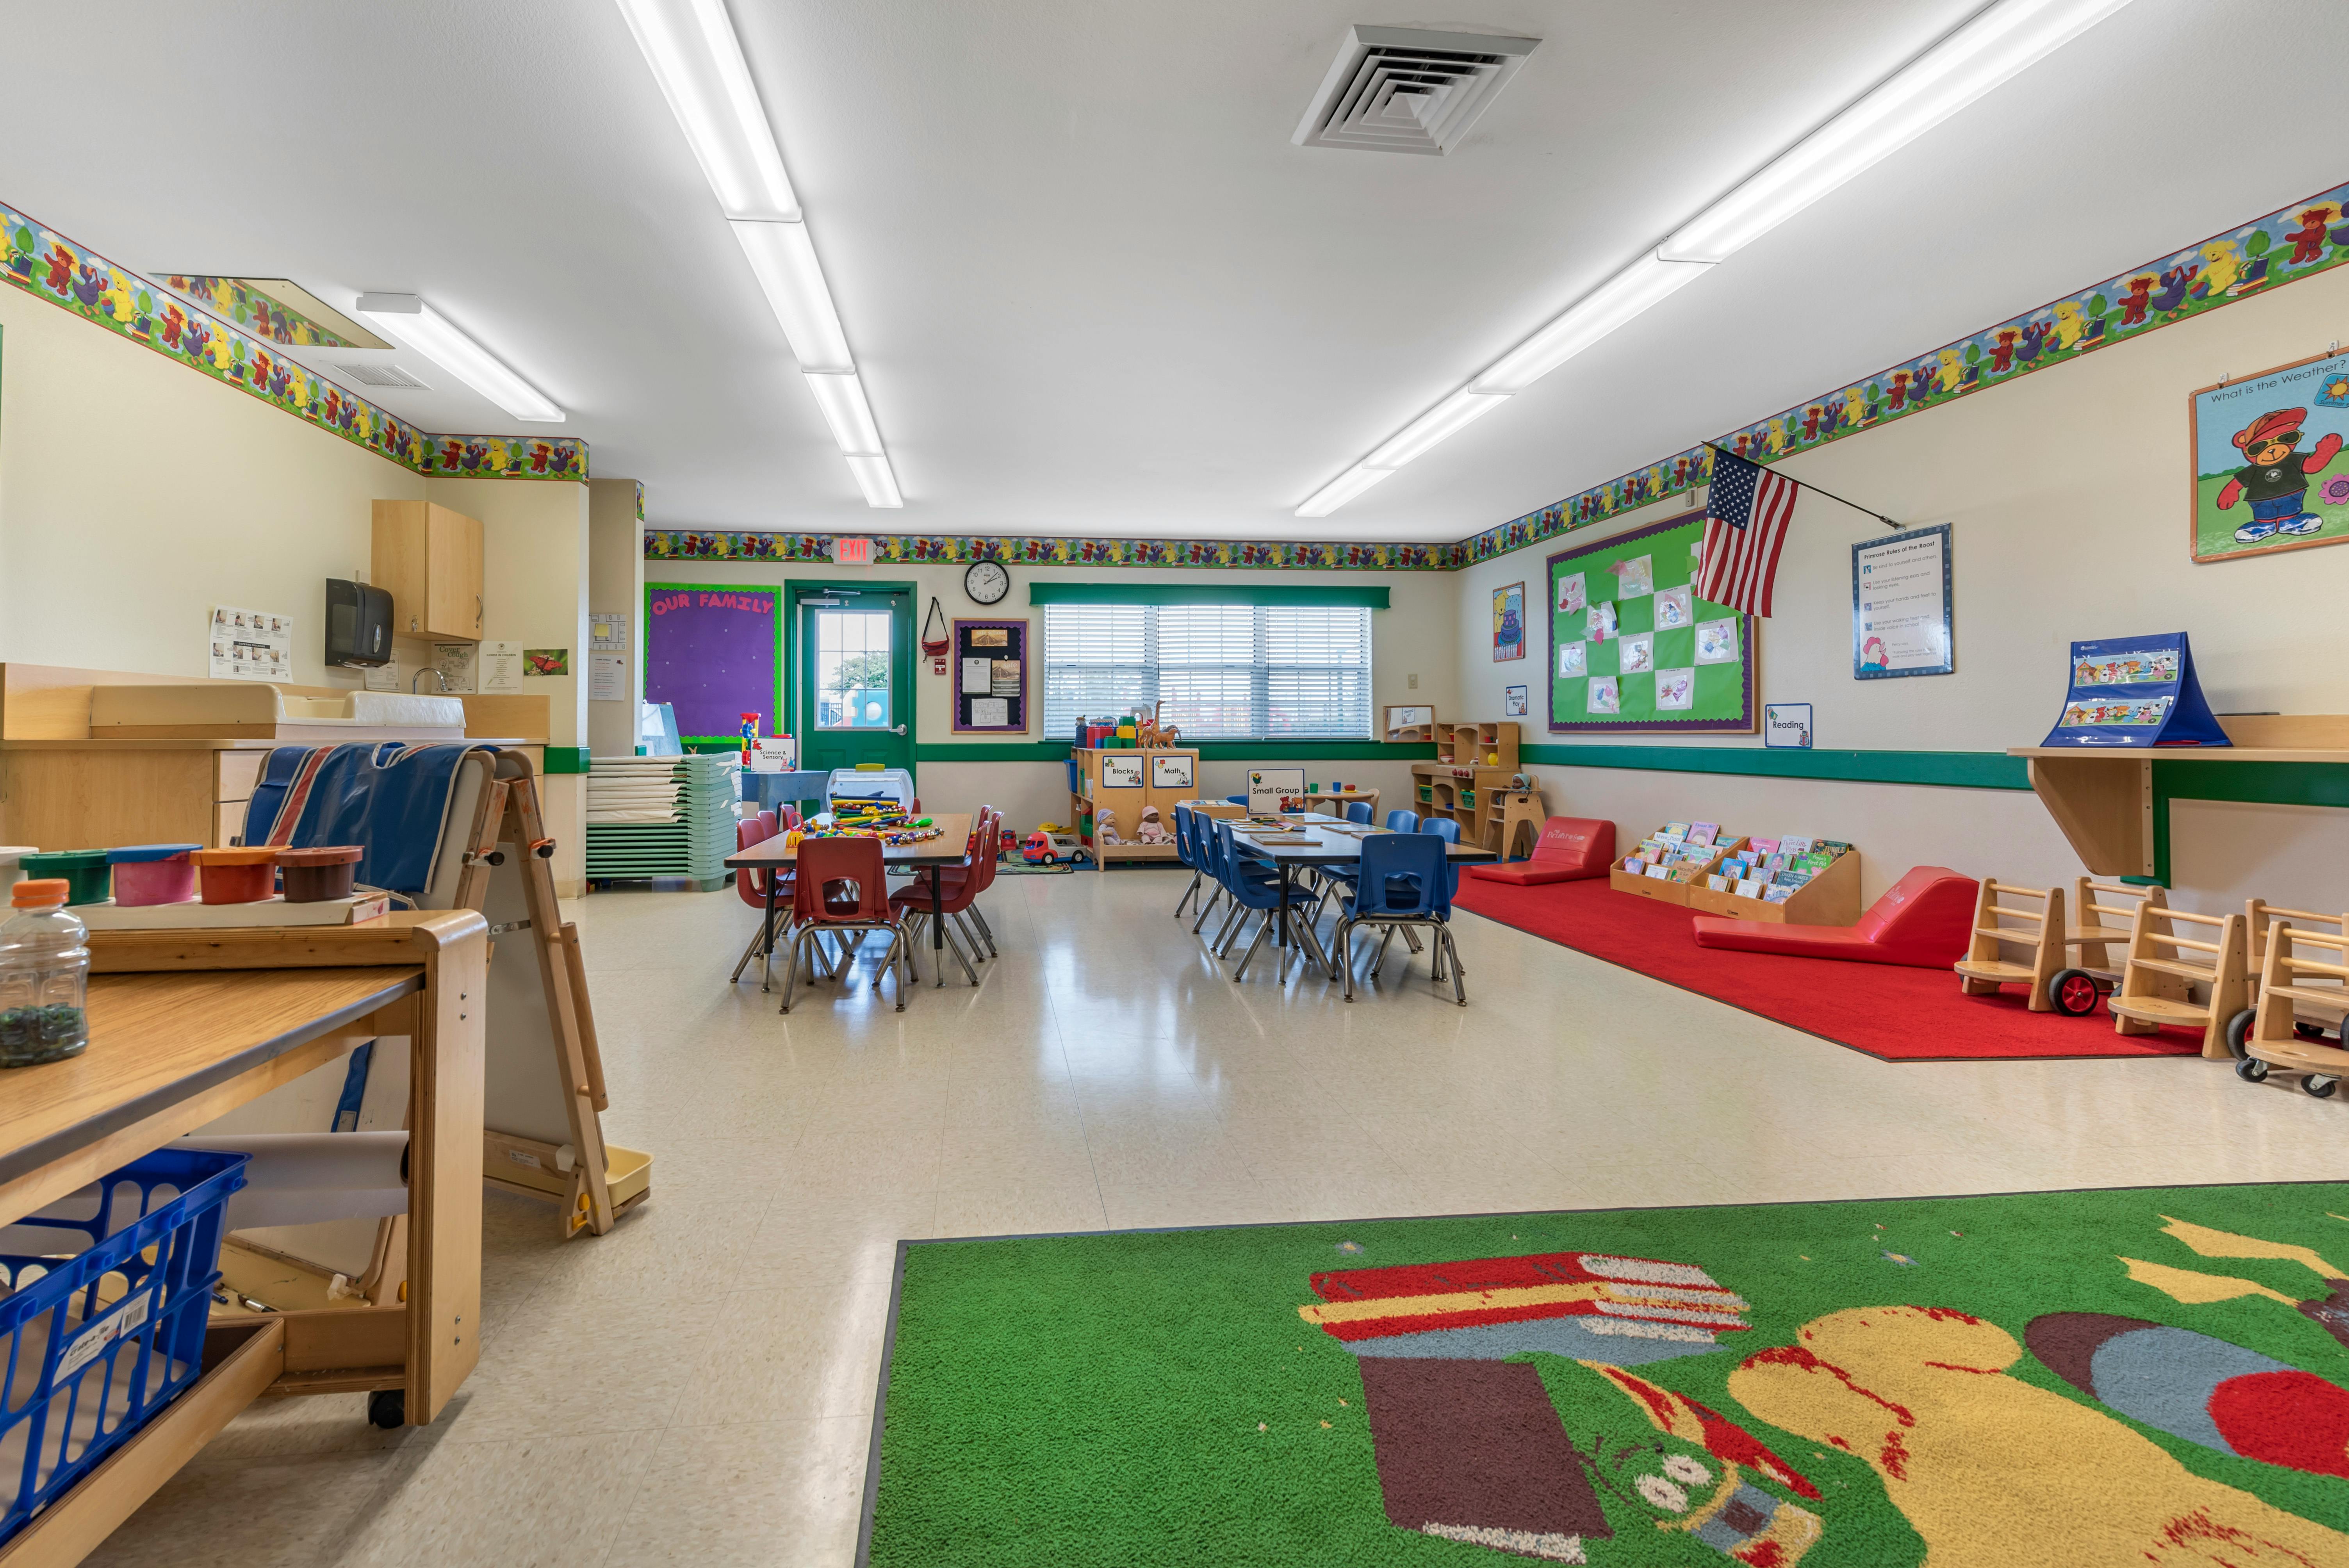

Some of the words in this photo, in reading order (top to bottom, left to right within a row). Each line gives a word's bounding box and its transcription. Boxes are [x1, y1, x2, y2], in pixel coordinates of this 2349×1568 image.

[2211, 388, 2242, 403] What
[2246, 386, 2253, 394] is
[2257, 380, 2278, 390] the
[2281, 359, 2346, 384] Weather?
[840, 540, 868, 561] EXIT
[652, 594, 690, 615] OUR
[699, 593, 773, 614] FAMILY
[1773, 721, 1804, 730] Reading
[1796, 839, 1807, 847] Little
